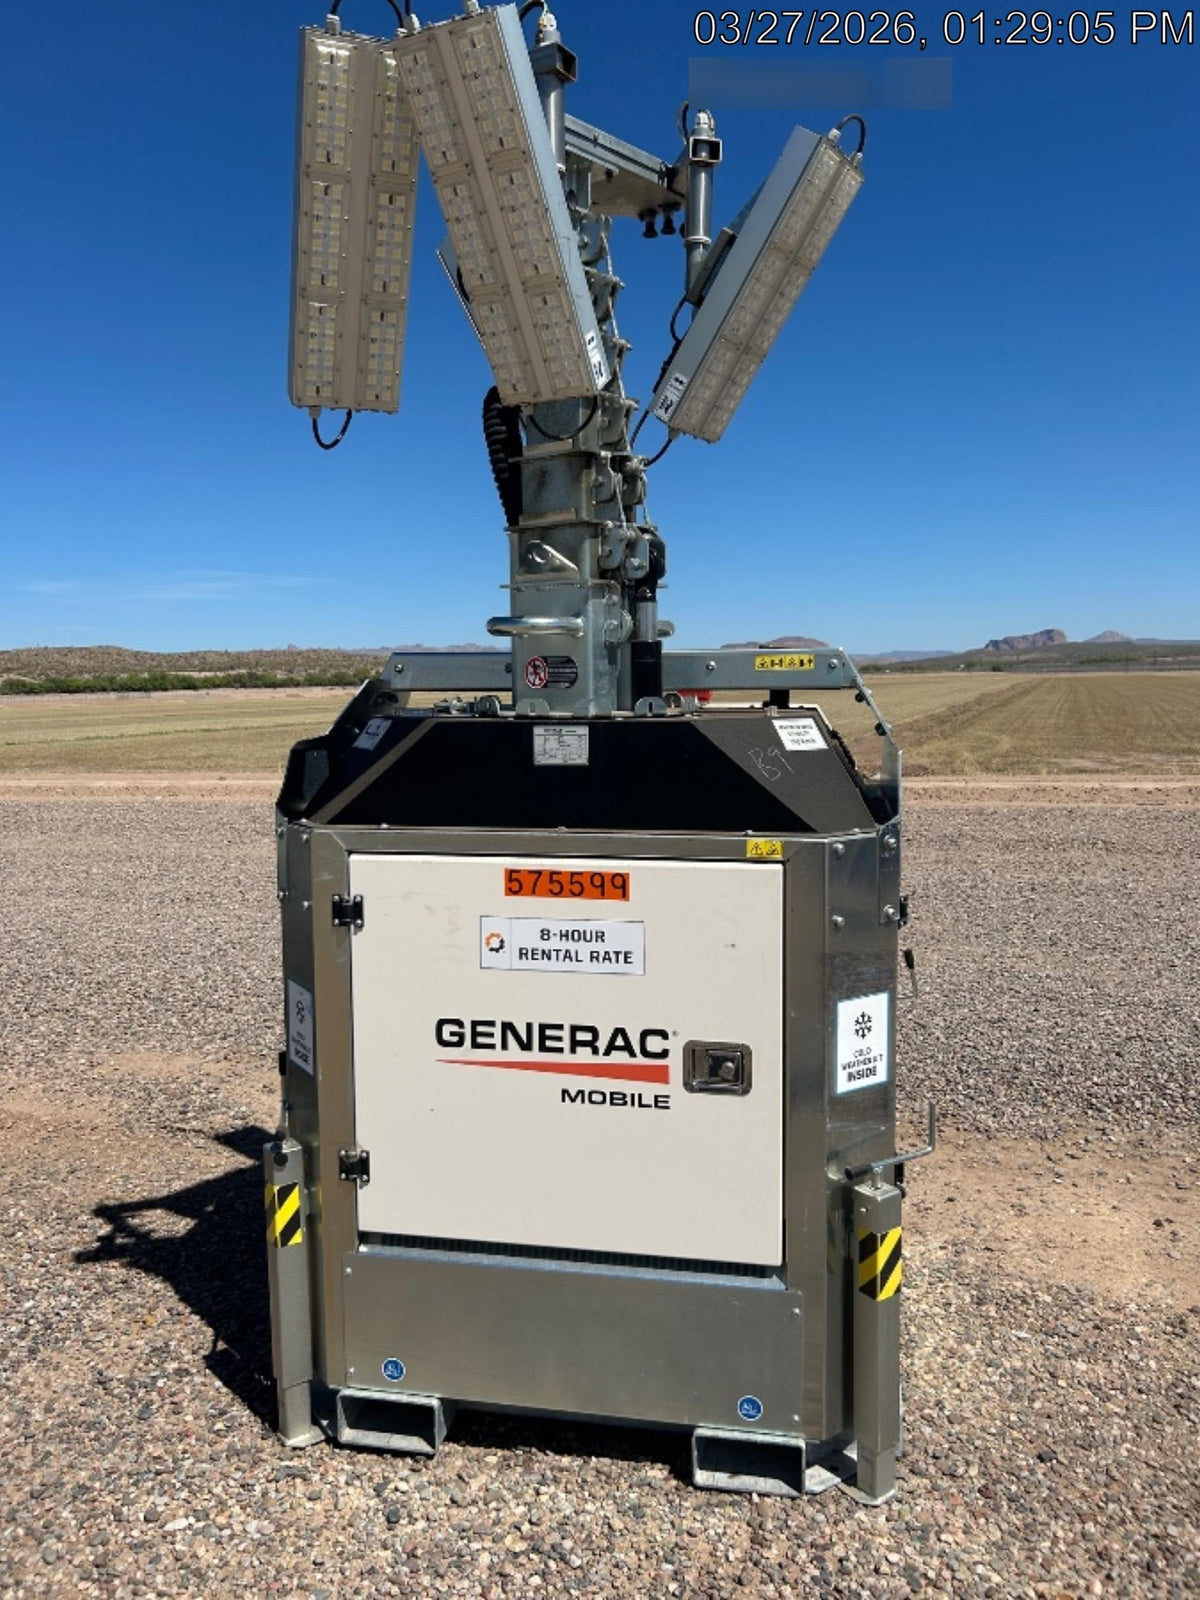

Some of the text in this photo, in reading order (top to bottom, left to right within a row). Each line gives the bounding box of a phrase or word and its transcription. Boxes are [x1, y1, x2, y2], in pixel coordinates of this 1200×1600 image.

[507, 869, 627, 898] 575599
[539, 927, 606, 944] 8-HOUR
[518, 947, 634, 965] RENTAL RATE
[435, 1017, 670, 1060] GENERAC
[846, 1066, 877, 1082] INSIDE
[561, 1088, 671, 1110] MOBILE
